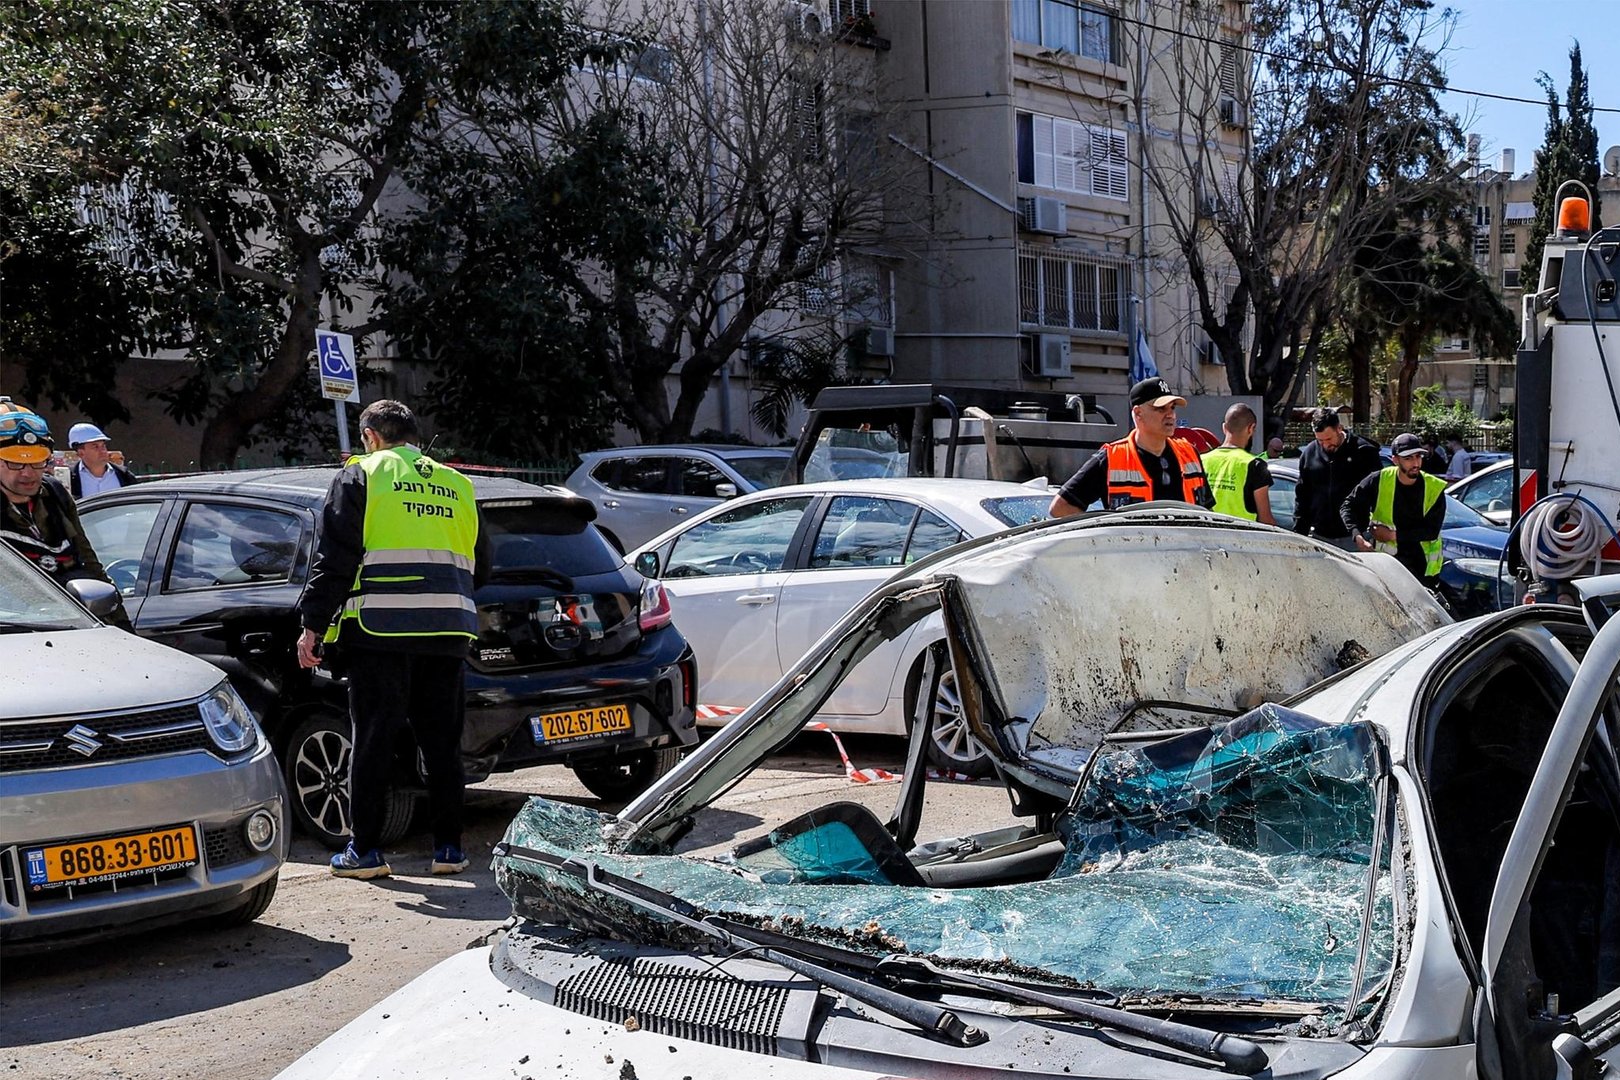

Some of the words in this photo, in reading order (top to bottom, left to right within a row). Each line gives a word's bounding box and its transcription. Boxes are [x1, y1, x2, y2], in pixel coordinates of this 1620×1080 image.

[393, 481, 425, 494] רובע
[427, 482, 459, 501] מנהל
[402, 501, 454, 519] בתפקיד
[31, 860, 44, 875] IL
